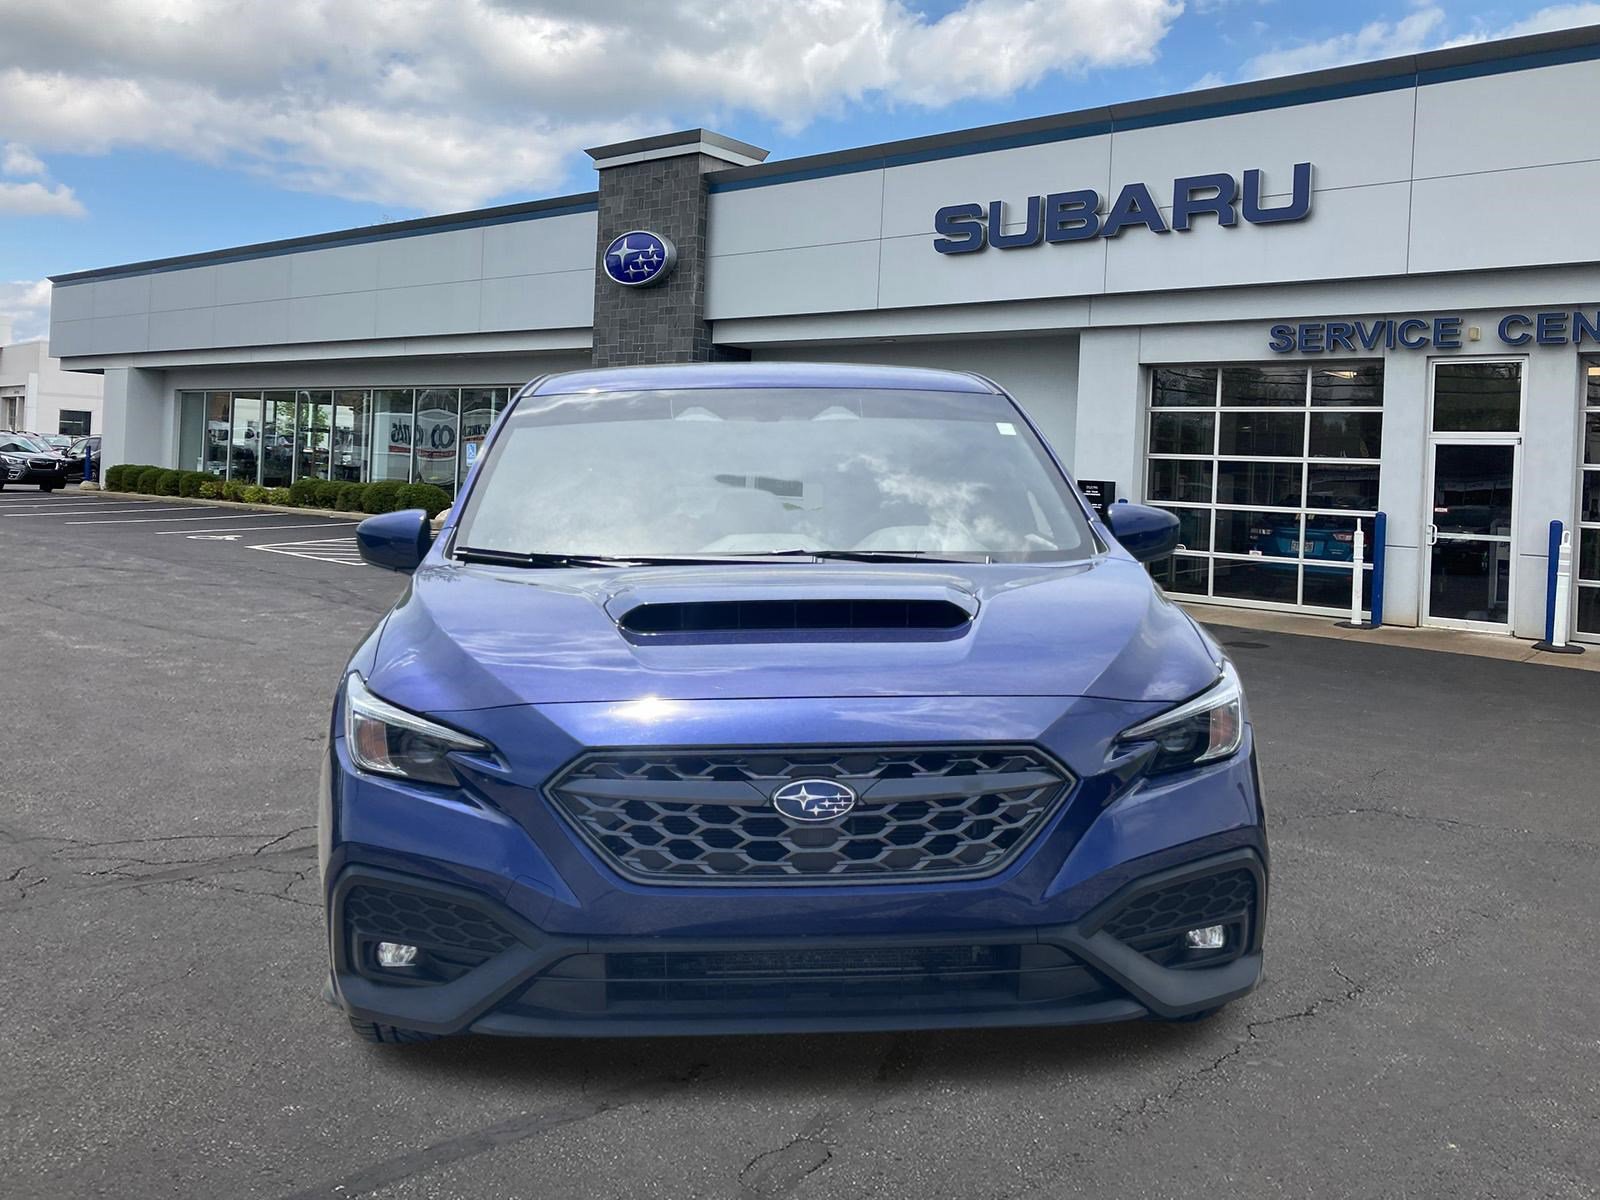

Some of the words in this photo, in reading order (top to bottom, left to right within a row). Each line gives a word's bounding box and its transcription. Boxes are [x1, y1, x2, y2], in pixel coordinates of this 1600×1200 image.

[933, 162, 1312, 255] SUBARU
[1269, 318, 1463, 352] SERVICE
[1498, 311, 1600, 346] CEN
